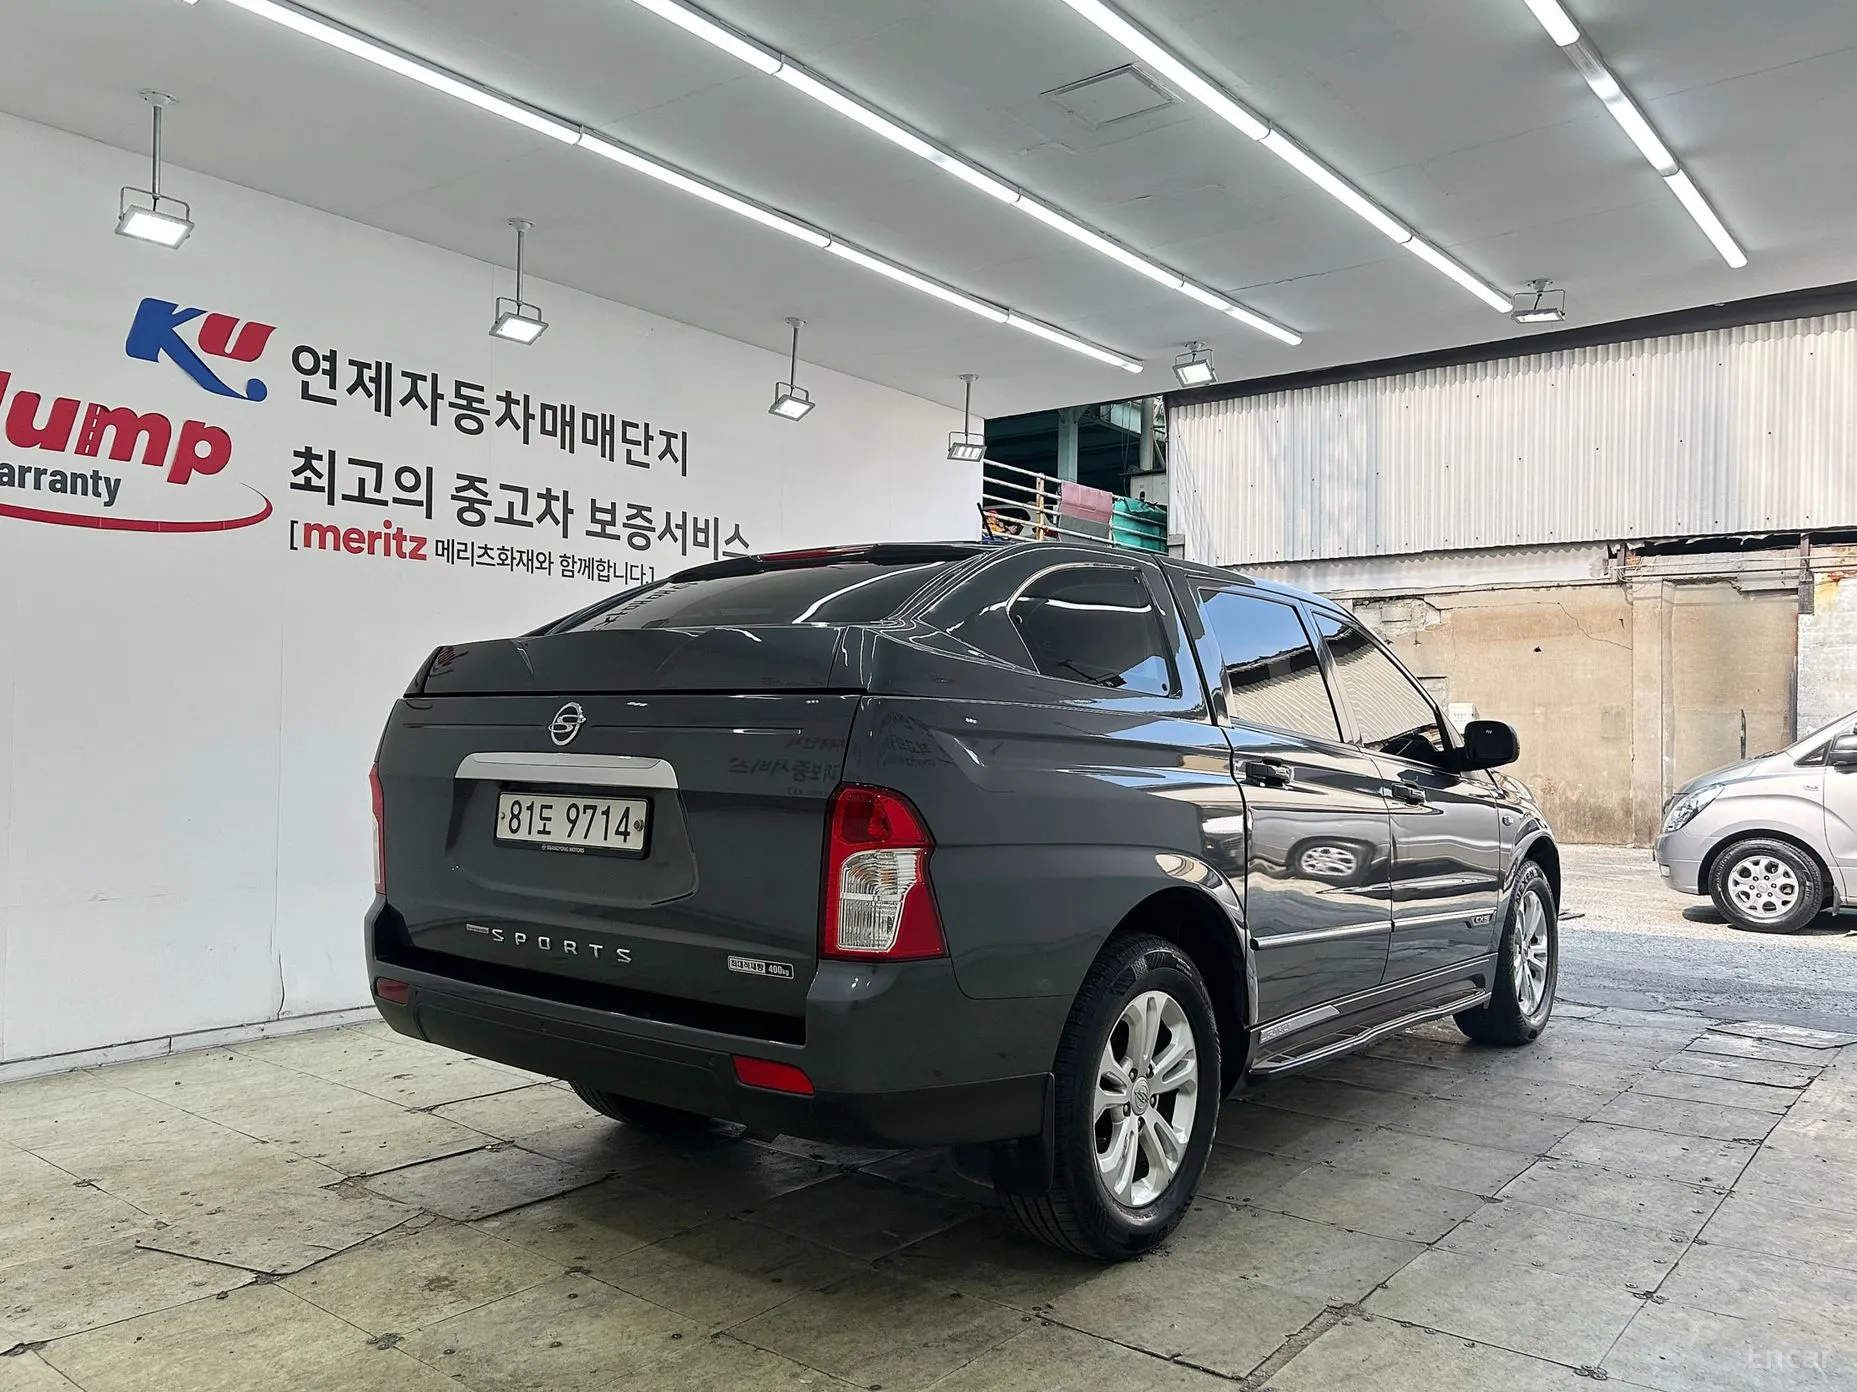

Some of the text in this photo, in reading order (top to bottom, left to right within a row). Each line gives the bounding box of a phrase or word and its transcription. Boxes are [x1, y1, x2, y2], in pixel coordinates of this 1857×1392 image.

[0, 370, 233, 485] ump
[291, 344, 688, 477] 연제자동차매매단지
[289, 446, 751, 561] 최고의 중고차 보증서비스
[434, 538, 555, 576] 메리츠화재와
[508, 800, 631, 843] 81도 9714
[491, 928, 632, 964] SPORTS
